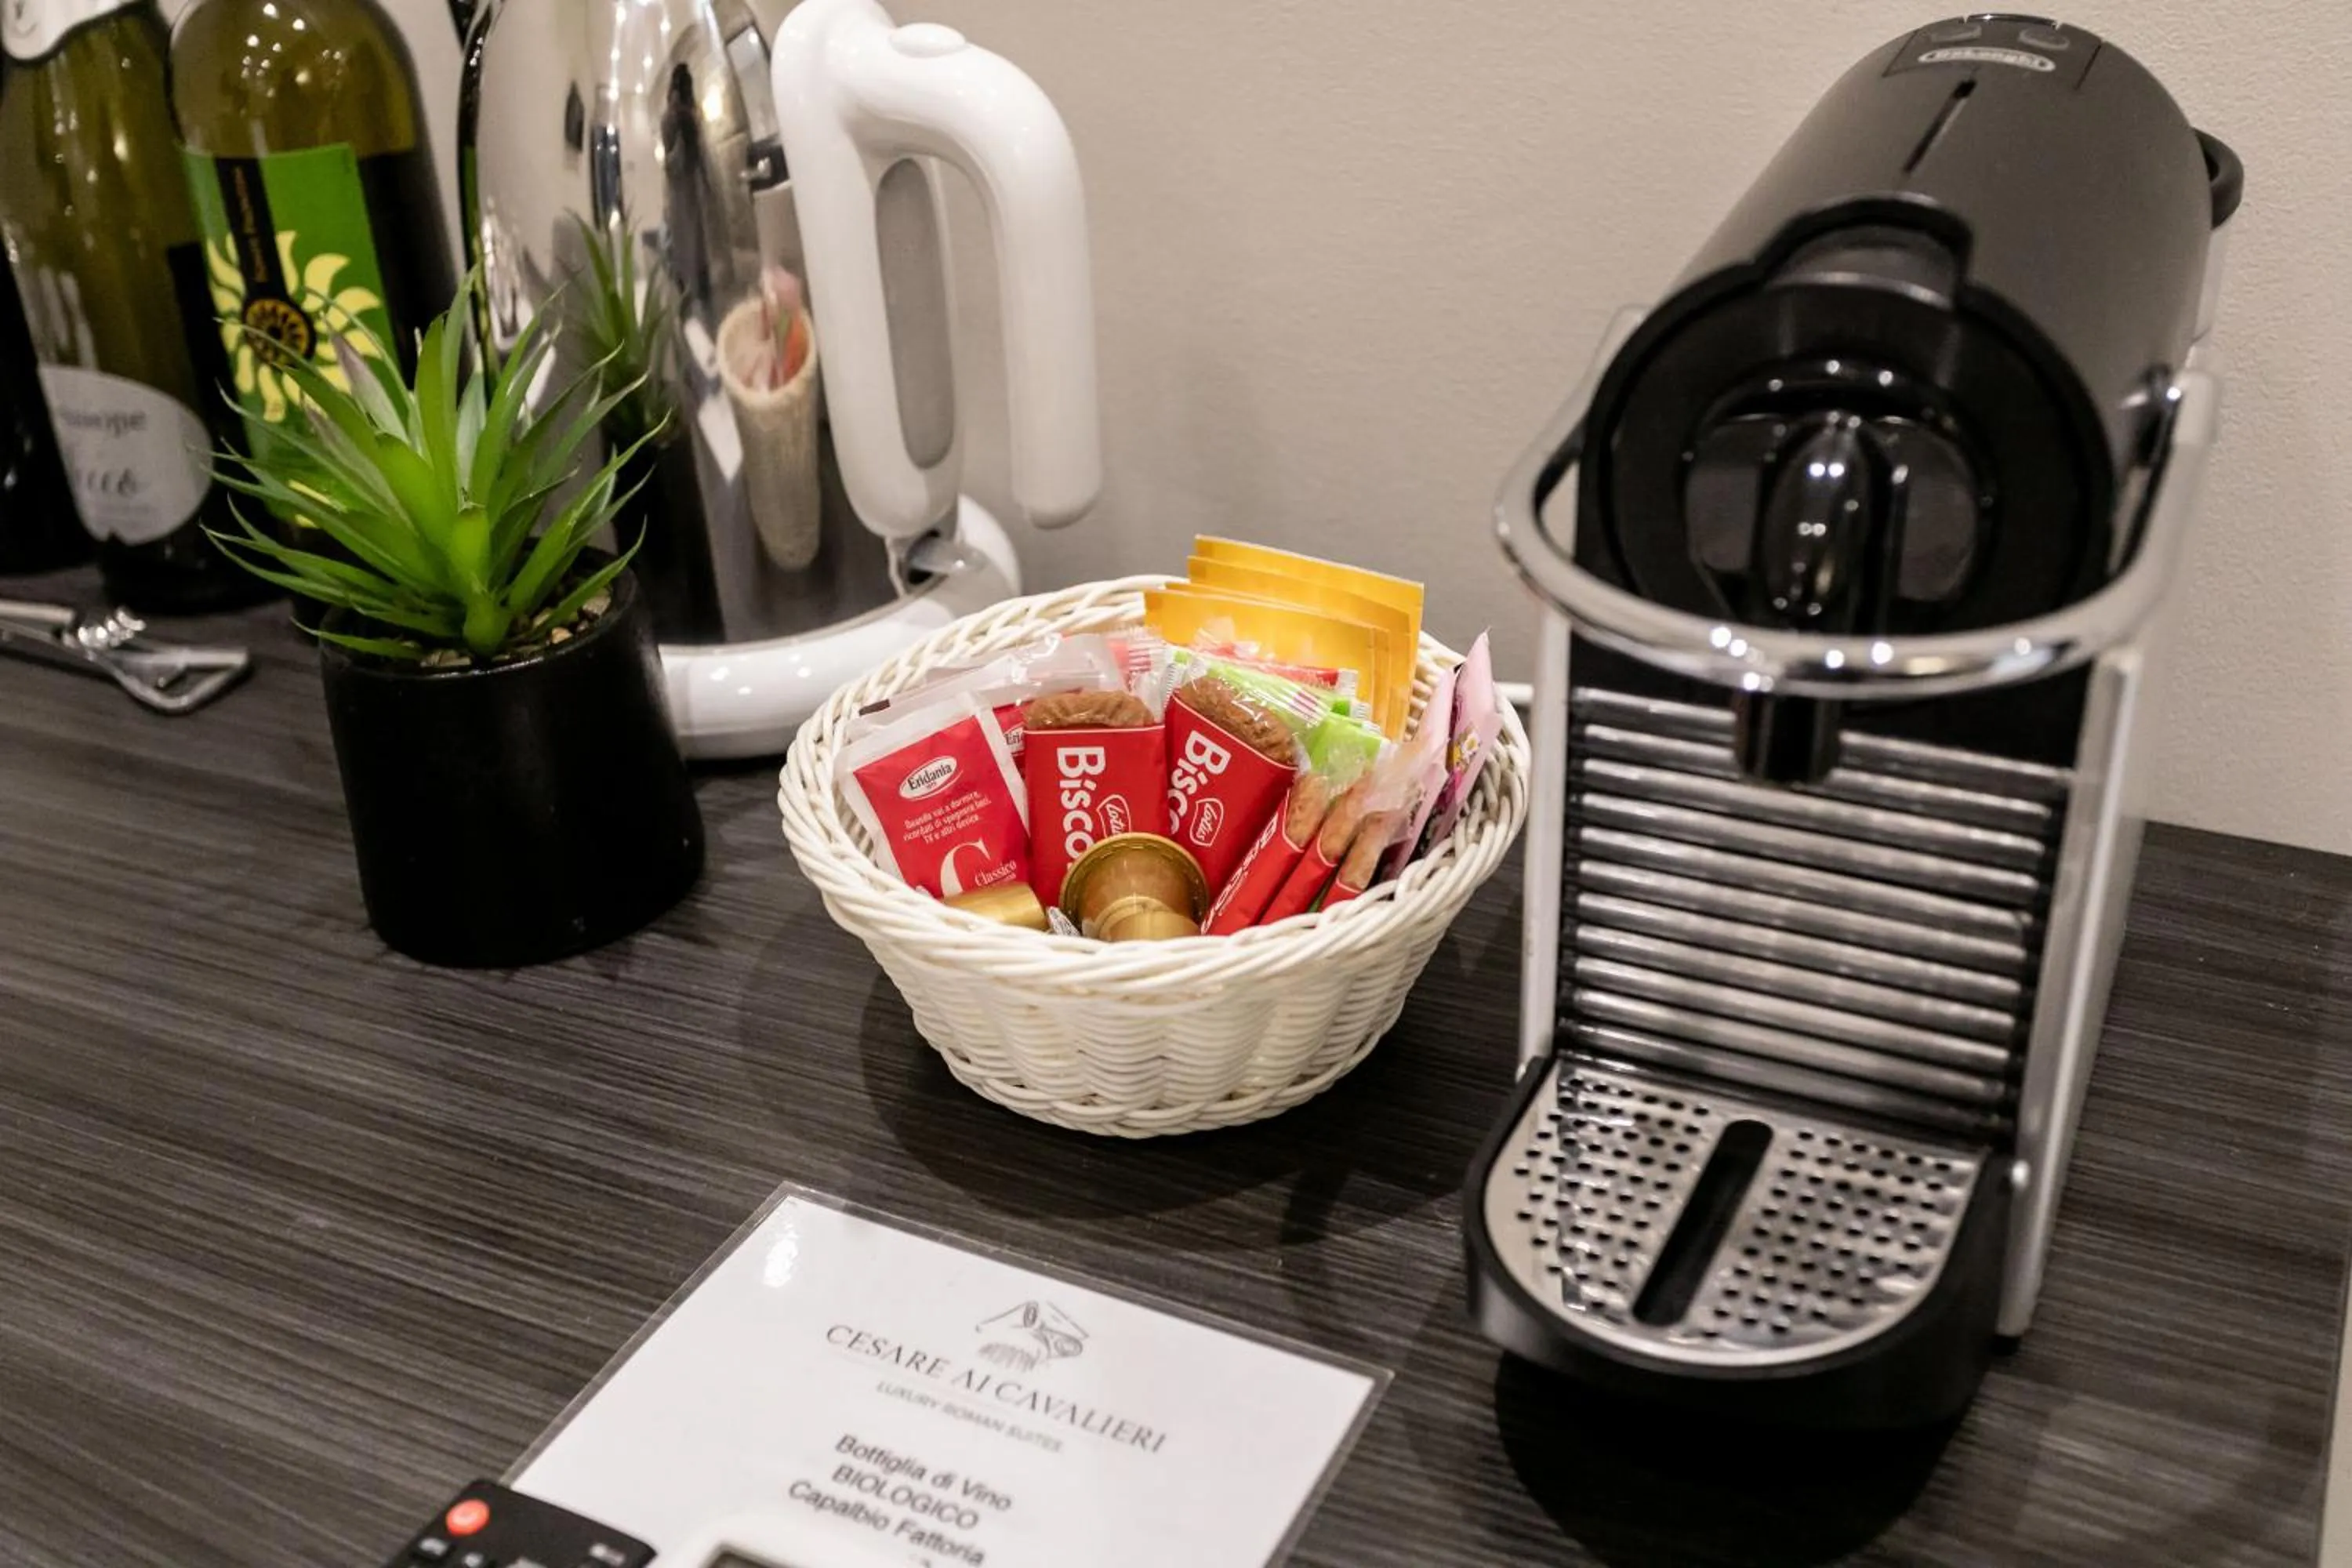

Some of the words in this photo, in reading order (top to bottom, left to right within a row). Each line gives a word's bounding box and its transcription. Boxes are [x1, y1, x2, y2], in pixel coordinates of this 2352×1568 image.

[908, 764, 953, 790] Eridania
[1057, 746, 1105, 870] Bisco
[975, 859, 1017, 887] Classico
[826, 1324, 951, 1378] CESARE
[877, 1381, 941, 1408] LUXURY
[942, 1402, 1005, 1432] ROMAN
[1006, 1423, 1064, 1453] SUITES
[832, 1465, 979, 1530] BIOLOGICO
[835, 1434, 927, 1481] Bottiglia
[931, 1471, 956, 1490] di
[960, 1478, 1011, 1511] Vino
[788, 1480, 891, 1530] Capalbio
[894, 1519, 985, 1566] Fattoria
